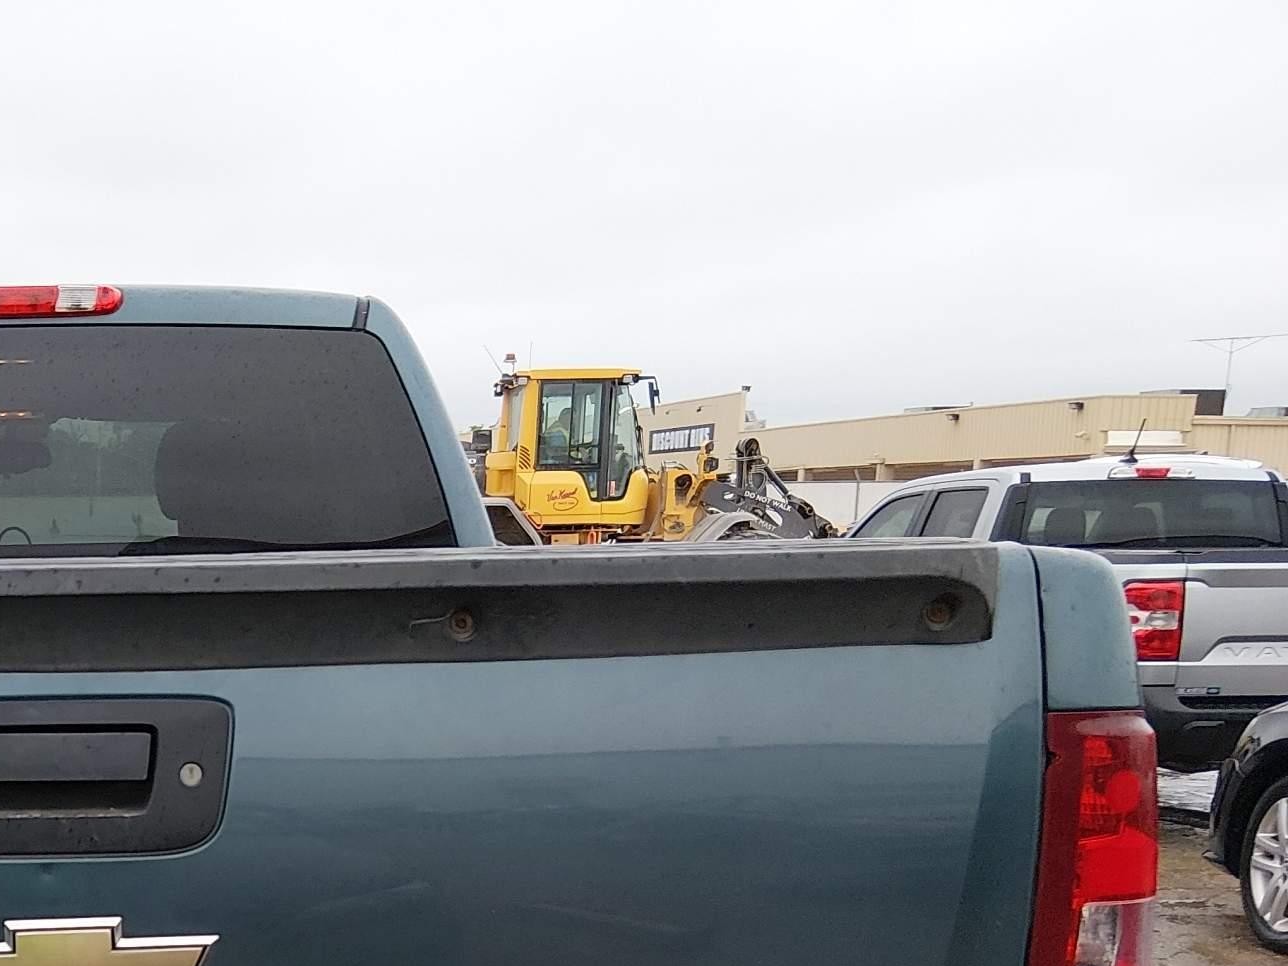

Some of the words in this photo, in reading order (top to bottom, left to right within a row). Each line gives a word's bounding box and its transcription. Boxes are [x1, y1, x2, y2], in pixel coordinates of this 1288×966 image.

[744, 490, 756, 499] DO
[755, 494, 771, 504] NOT
[771, 500, 792, 512] WALK
